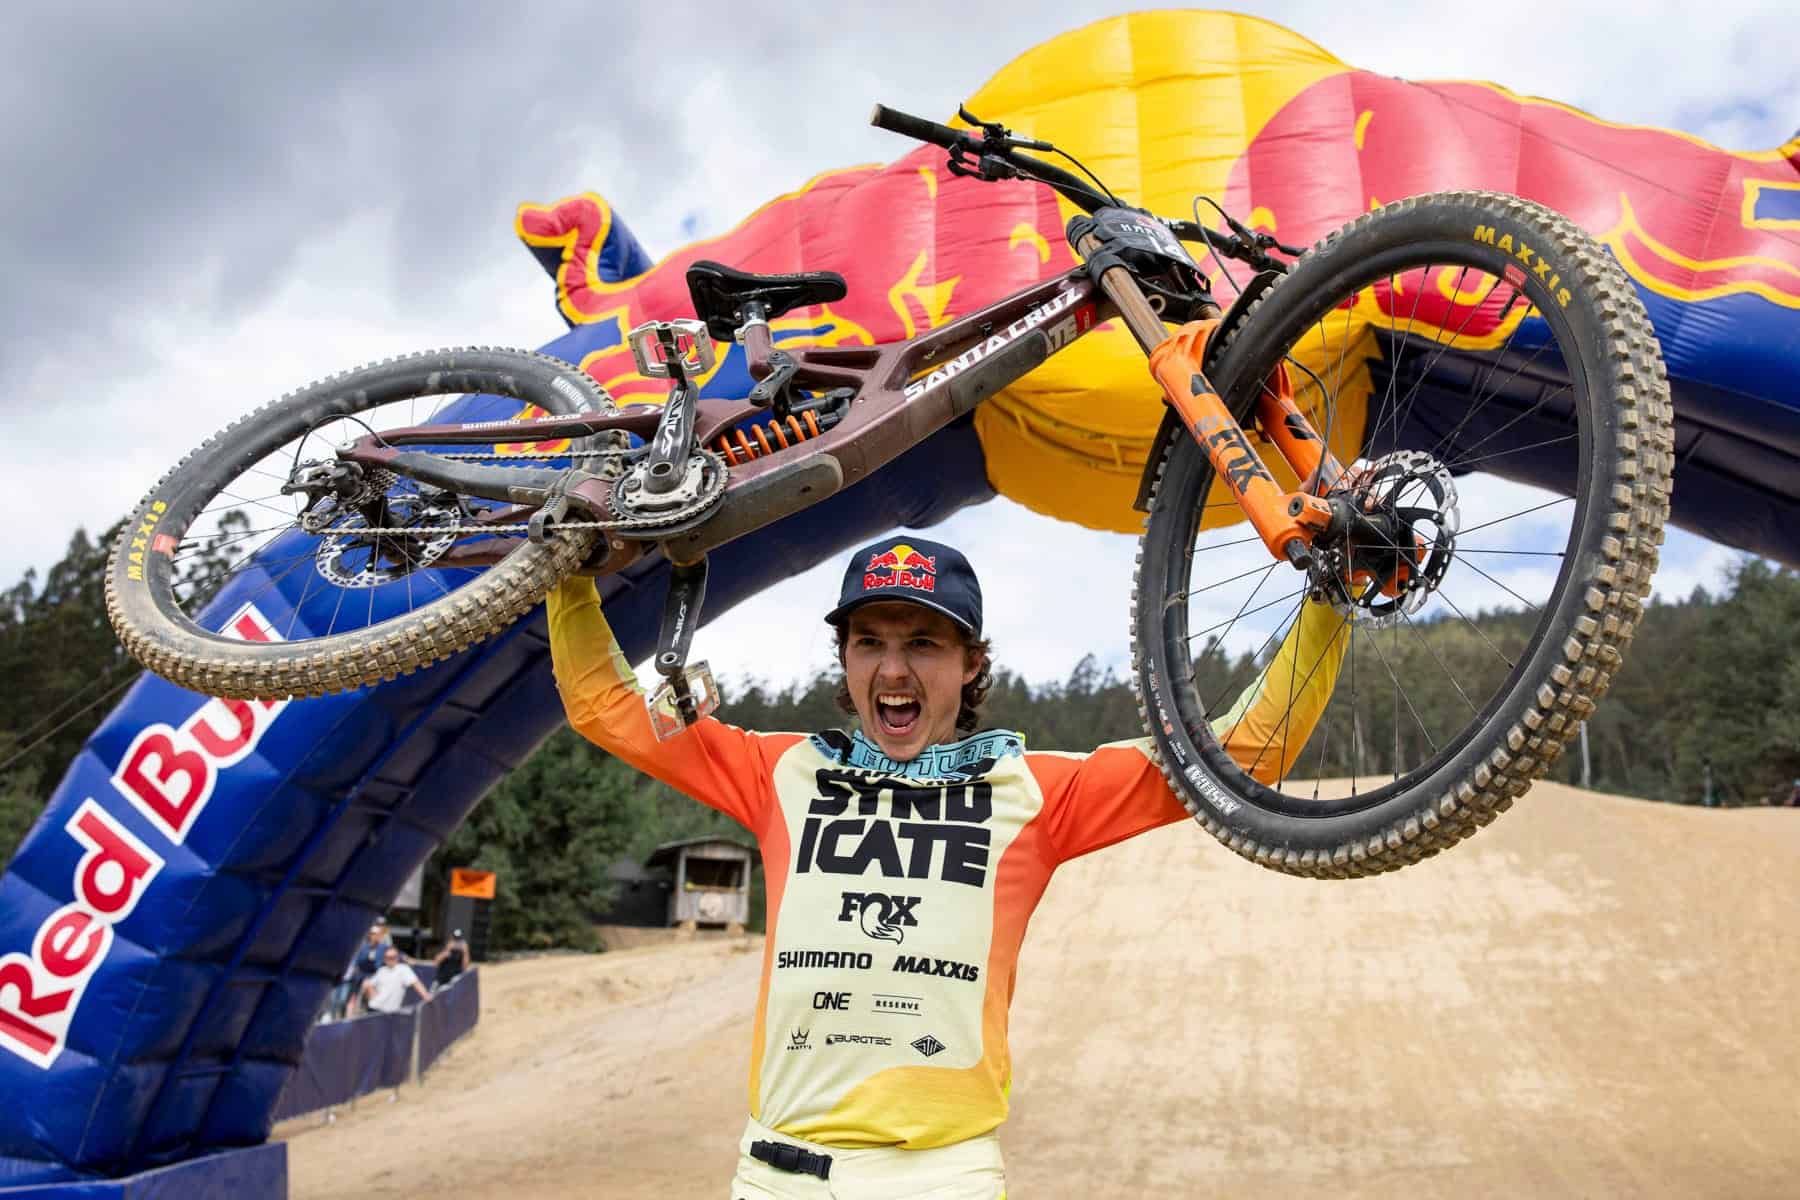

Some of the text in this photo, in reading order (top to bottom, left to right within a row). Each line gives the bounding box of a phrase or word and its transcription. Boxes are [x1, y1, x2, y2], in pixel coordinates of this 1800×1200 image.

[1473, 224, 1572, 309] MAXXIS
[903, 287, 1084, 403] SANTA CRUZ
[1203, 427, 1273, 496] FOX
[127, 499, 168, 582] MAXXIS
[863, 570, 935, 592] Red Bull
[808, 768, 992, 824] SYND
[796, 817, 992, 888] ICATE
[0, 798, 165, 1069] Red
[838, 891, 922, 930] FOX
[777, 950, 873, 971] SHIMANO
[892, 954, 980, 983] MAXXIS
[813, 991, 852, 1011] ONE
[874, 999, 920, 1012] RESERVE
